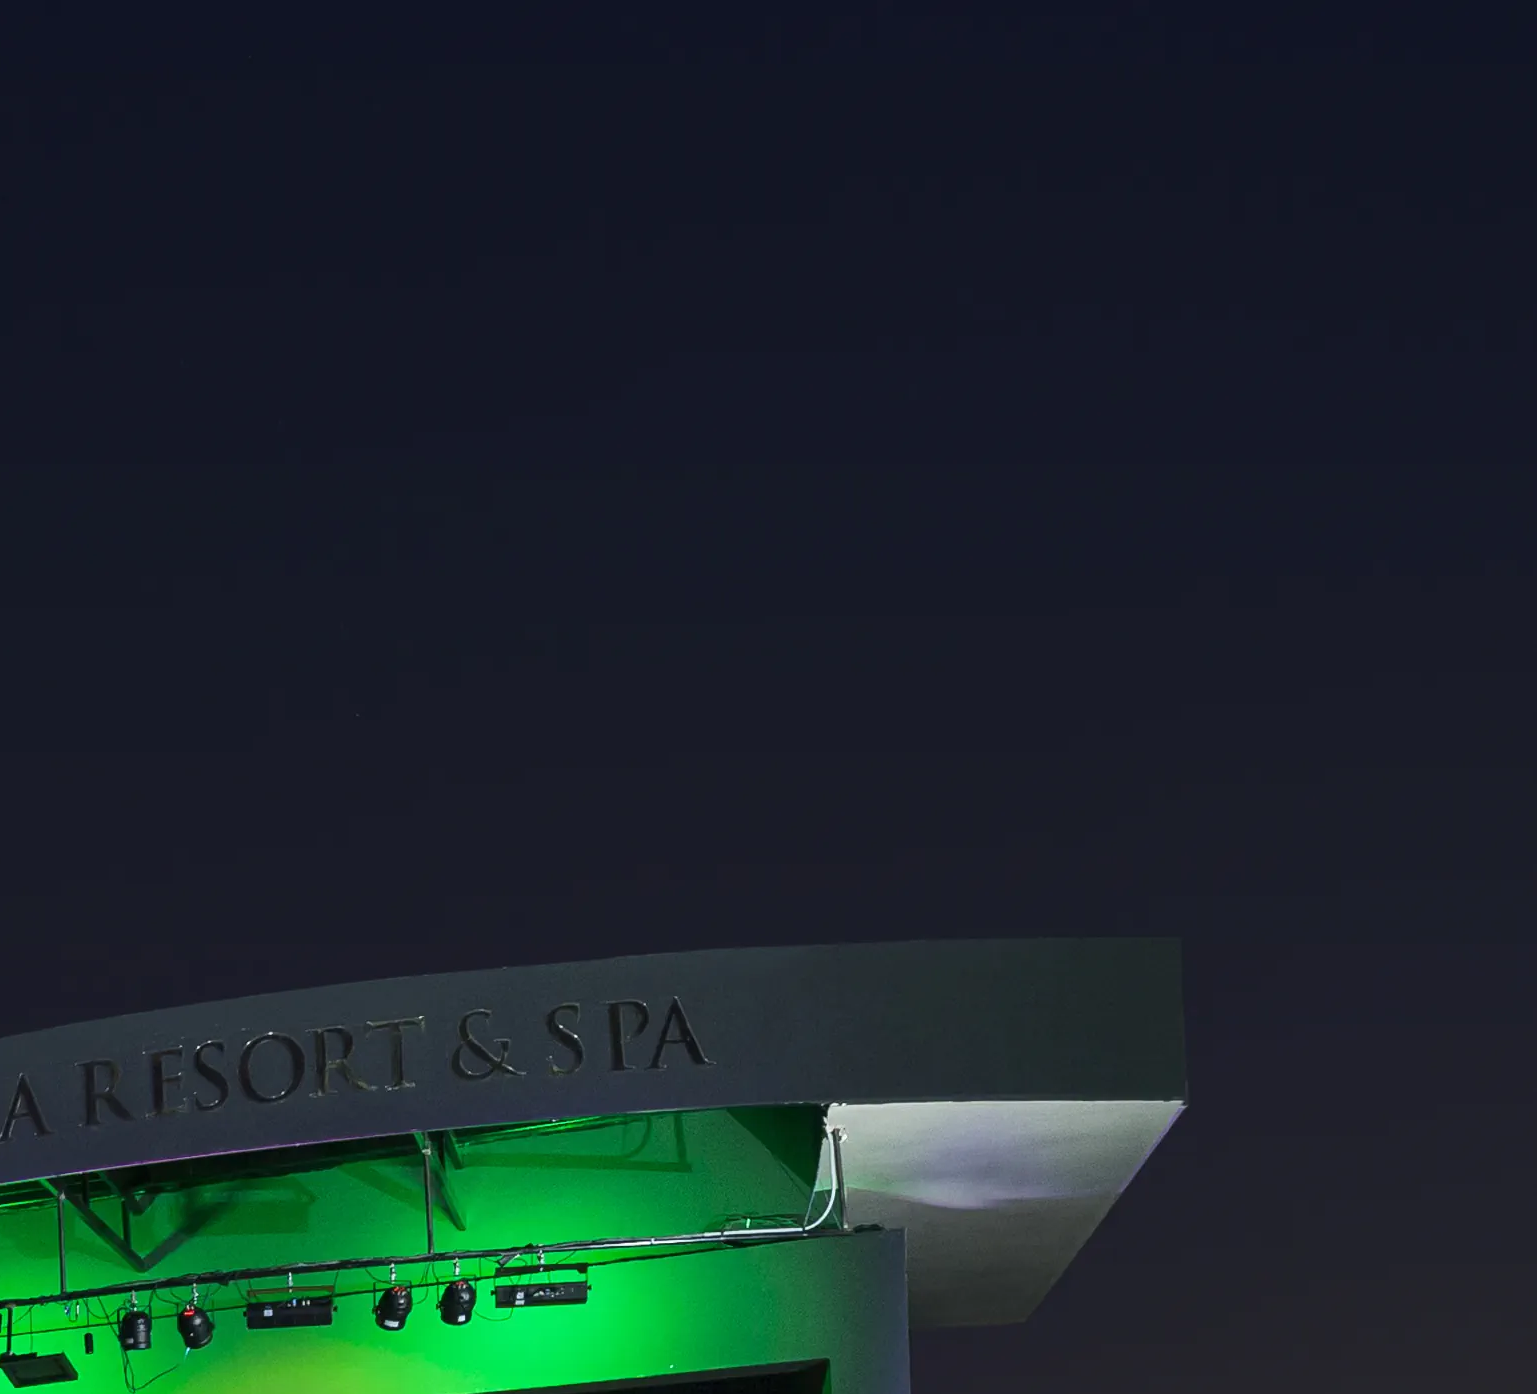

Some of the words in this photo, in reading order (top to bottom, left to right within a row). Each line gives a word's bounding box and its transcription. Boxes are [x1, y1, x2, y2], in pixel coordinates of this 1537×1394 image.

[75, 1016, 425, 1127] RESORT
[451, 1008, 527, 1081] &
[545, 995, 717, 1076] SPA
